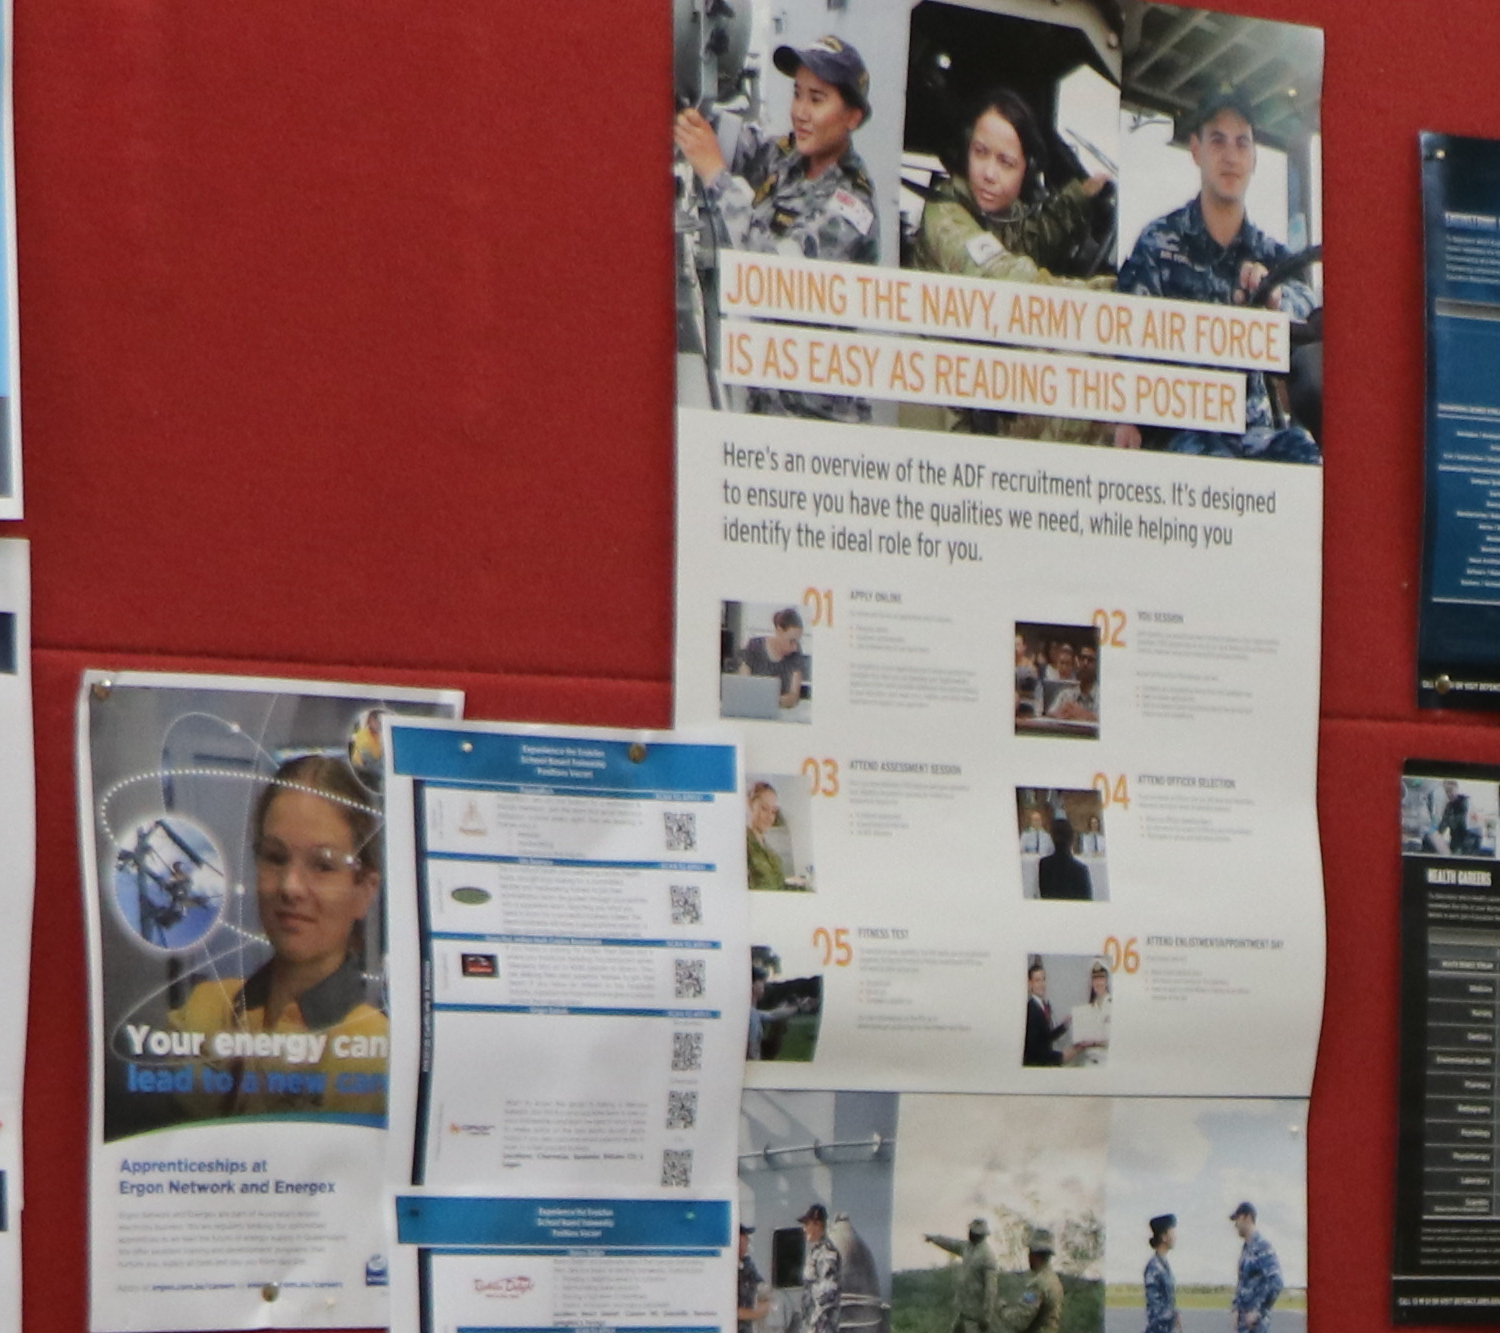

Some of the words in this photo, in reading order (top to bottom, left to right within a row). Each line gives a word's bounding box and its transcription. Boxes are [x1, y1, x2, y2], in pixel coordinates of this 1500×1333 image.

[725, 264, 845, 317] JOINING
[859, 279, 912, 322] THE
[922, 287, 997, 334] NAVY,
[1008, 296, 1087, 341] ARMY
[1096, 305, 1132, 343] OR
[1142, 309, 1185, 352] AIR
[1197, 314, 1280, 363] FORCE
[728, 333, 752, 375] IS
[763, 338, 798, 379] AS
[809, 343, 879, 388] EASY
[890, 351, 926, 393] AS
[935, 355, 1057, 406] READING
[1067, 367, 1127, 412] THIS
[1137, 376, 1236, 424] POSTER
[723, 443, 778, 470] Here's
[786, 451, 804, 473] an
[811, 455, 890, 480] overview
[896, 460, 913, 483] of
[919, 462, 946, 486] the
[953, 464, 985, 489] ADF
[991, 471, 1091, 499] recruitment
[1098, 482, 1166, 512] process.
[1172, 483, 1196, 509] It's
[1201, 486, 1276, 518] designed
[127, 1025, 204, 1056] Your
[214, 1031, 326, 1062] energy
[334, 1034, 388, 1058] can
[120, 1159, 247, 1178] Apprenticeships
[252, 1160, 267, 1172] at
[120, 1182, 164, 1198] Ergon
[169, 1181, 236, 1194] Network
[240, 1181, 270, 1194] and
[274, 1180, 336, 1196] Energex
